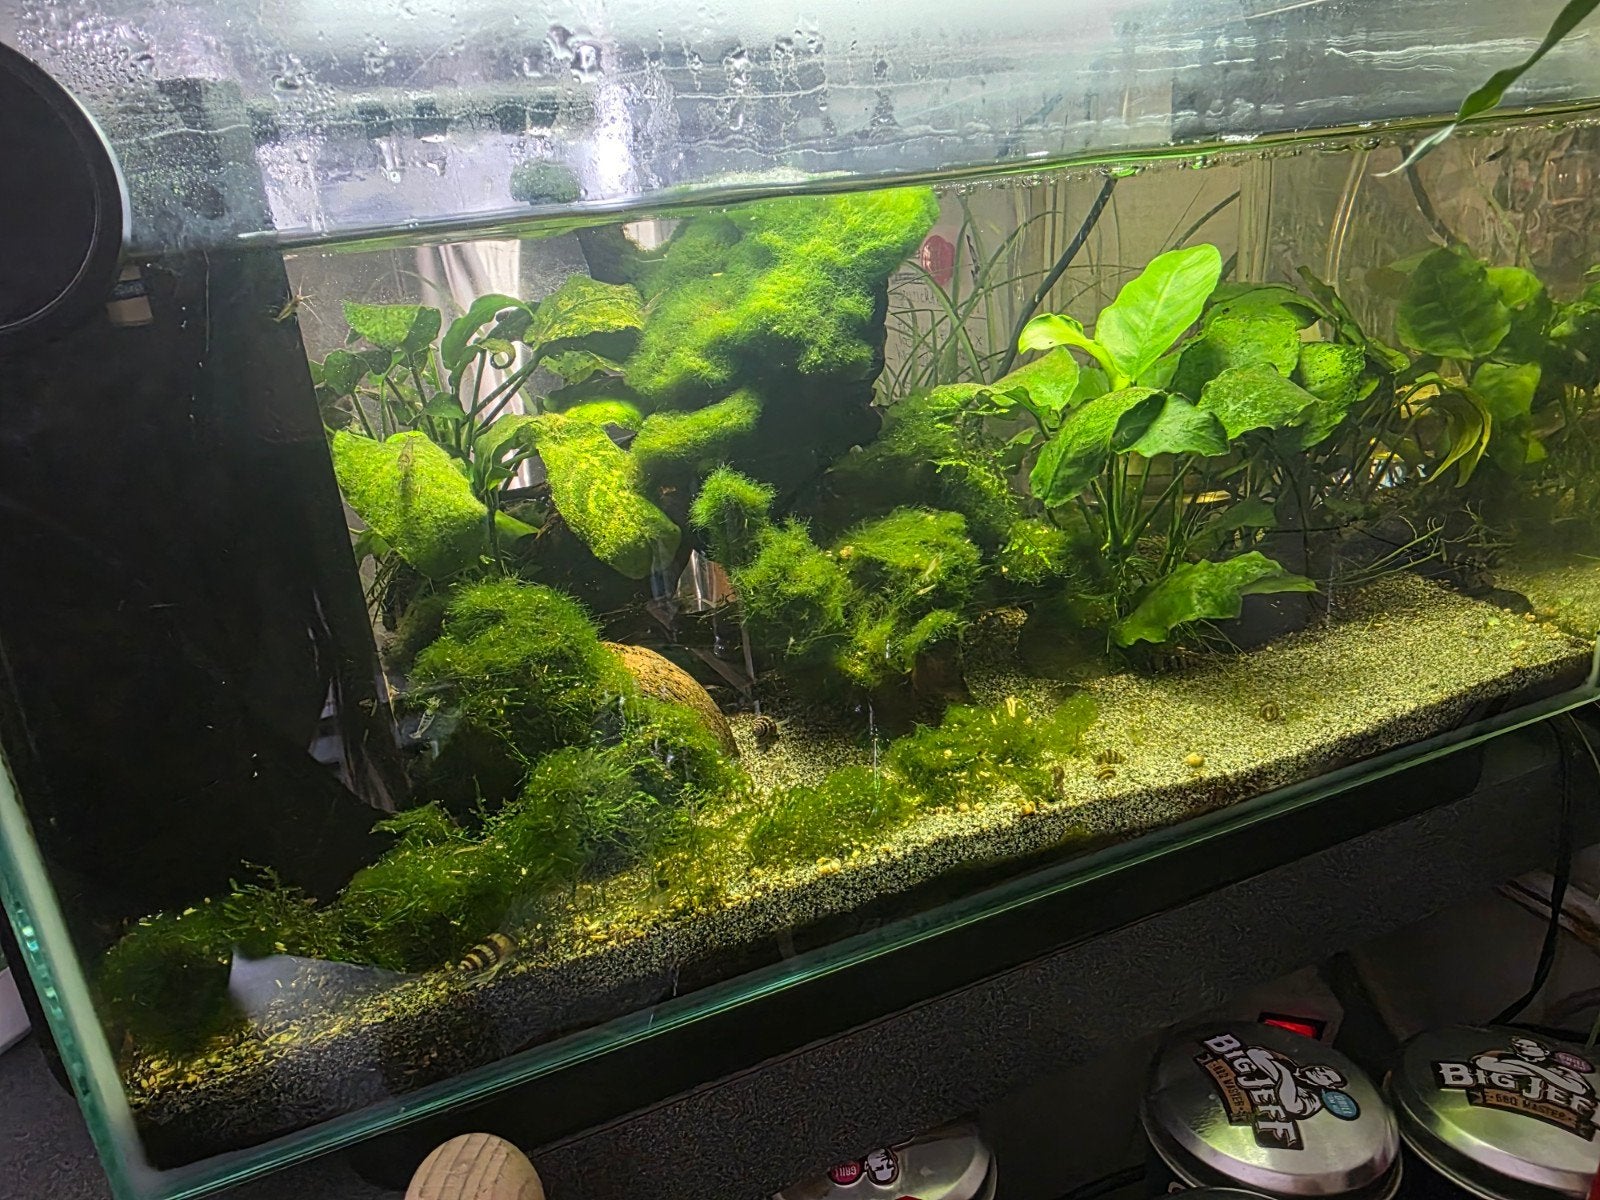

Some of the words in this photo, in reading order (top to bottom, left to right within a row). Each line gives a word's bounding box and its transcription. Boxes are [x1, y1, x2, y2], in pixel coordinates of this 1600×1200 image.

[1203, 1033, 1258, 1076] BIG
[1237, 1076, 1297, 1145] JEFF
[1438, 1062, 1517, 1089] BIG
